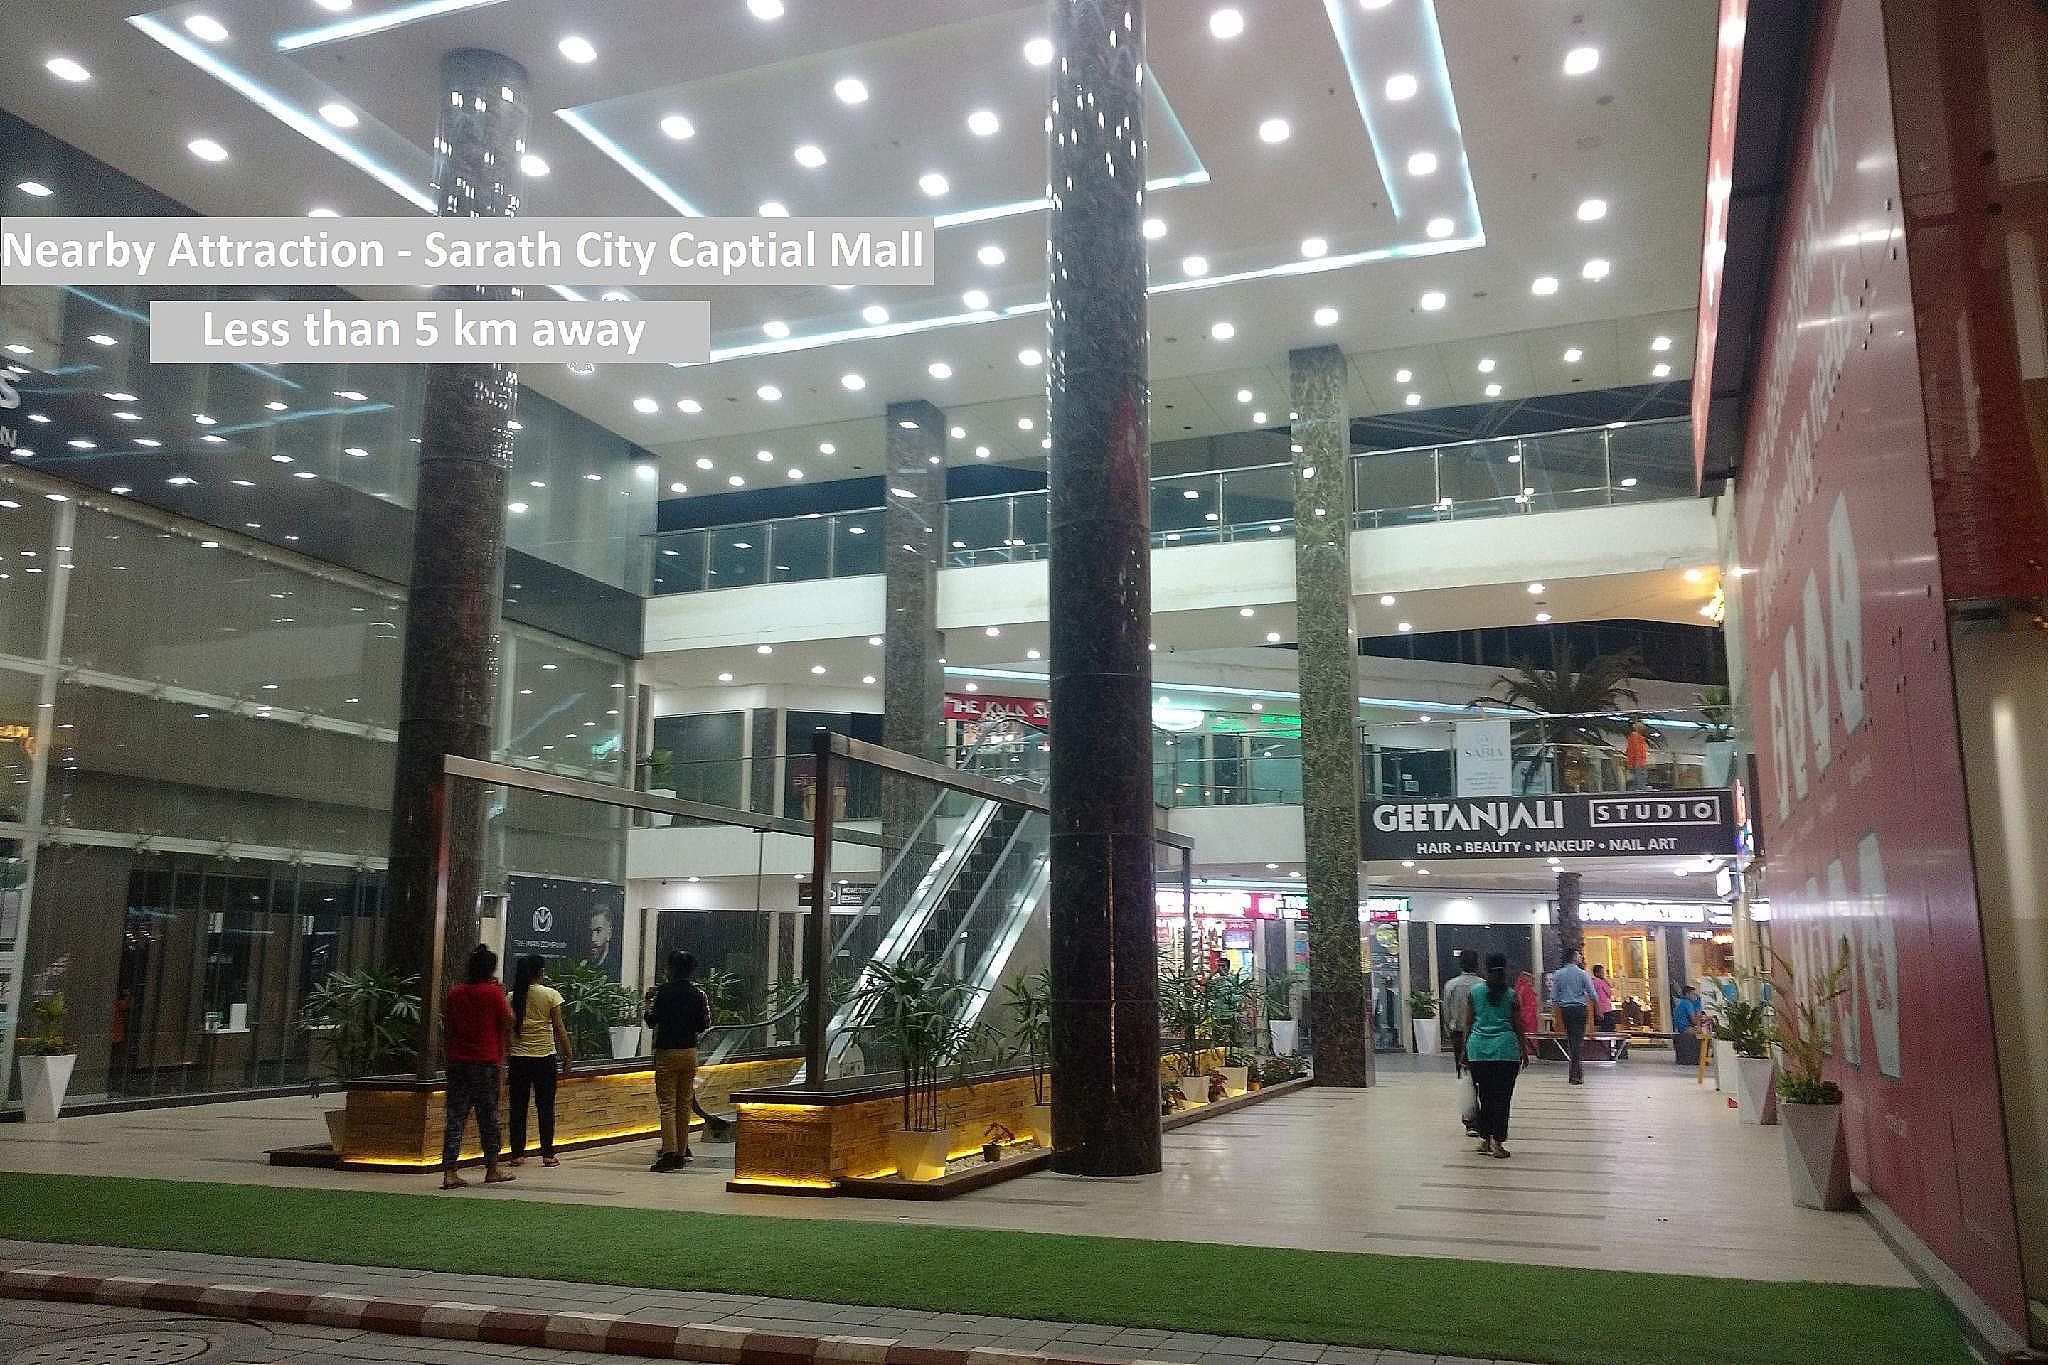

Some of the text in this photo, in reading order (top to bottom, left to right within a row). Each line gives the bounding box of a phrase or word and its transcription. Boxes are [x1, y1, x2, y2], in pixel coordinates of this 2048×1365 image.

[1373, 801, 1713, 837] GEETANJALI STUDIO
[1416, 837, 1678, 854] HAIR BEAUTY MAKEUP NAIL ART
